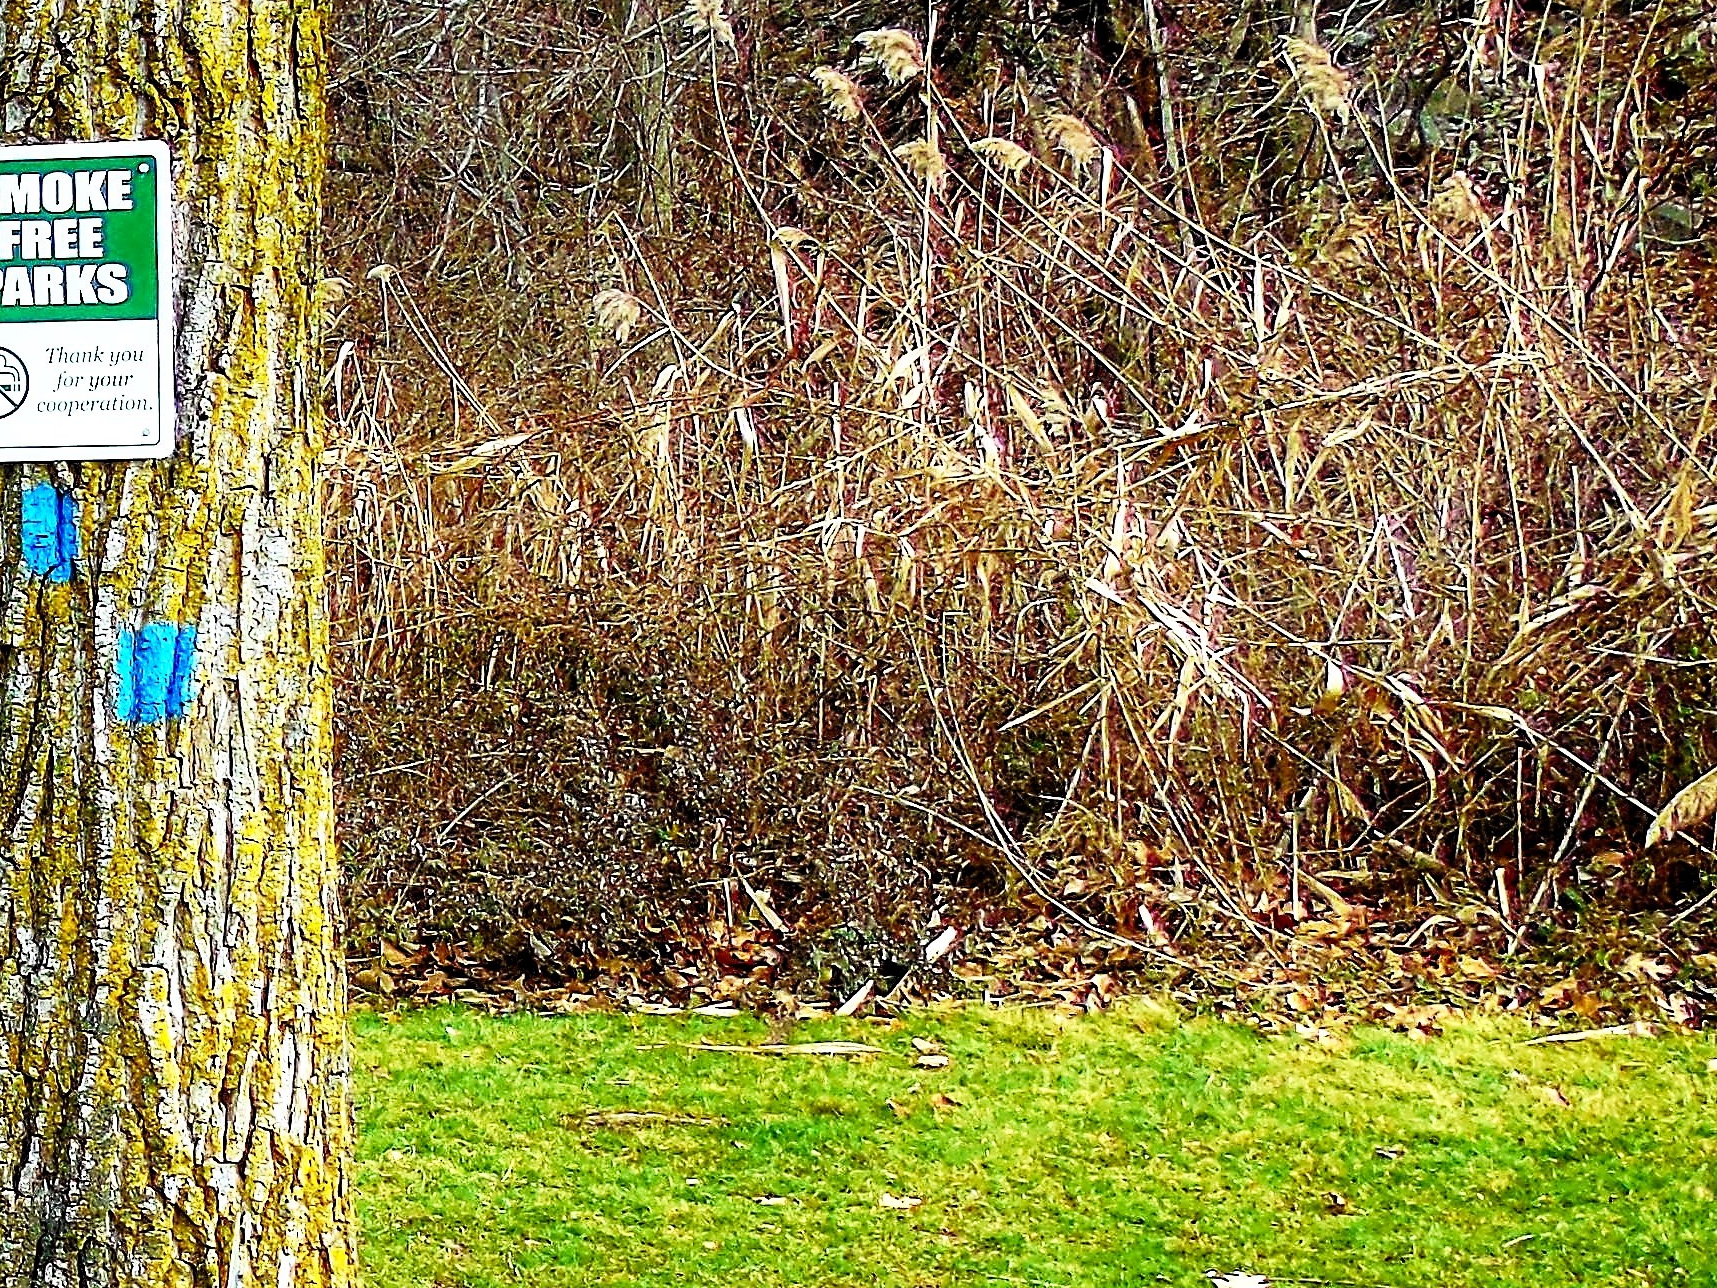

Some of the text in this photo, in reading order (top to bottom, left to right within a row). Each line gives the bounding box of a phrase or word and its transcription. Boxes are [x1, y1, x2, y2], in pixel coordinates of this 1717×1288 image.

[46, 345, 144, 367] Thank you
[53, 371, 134, 392] for your
[37, 394, 153, 417] cooperation.
